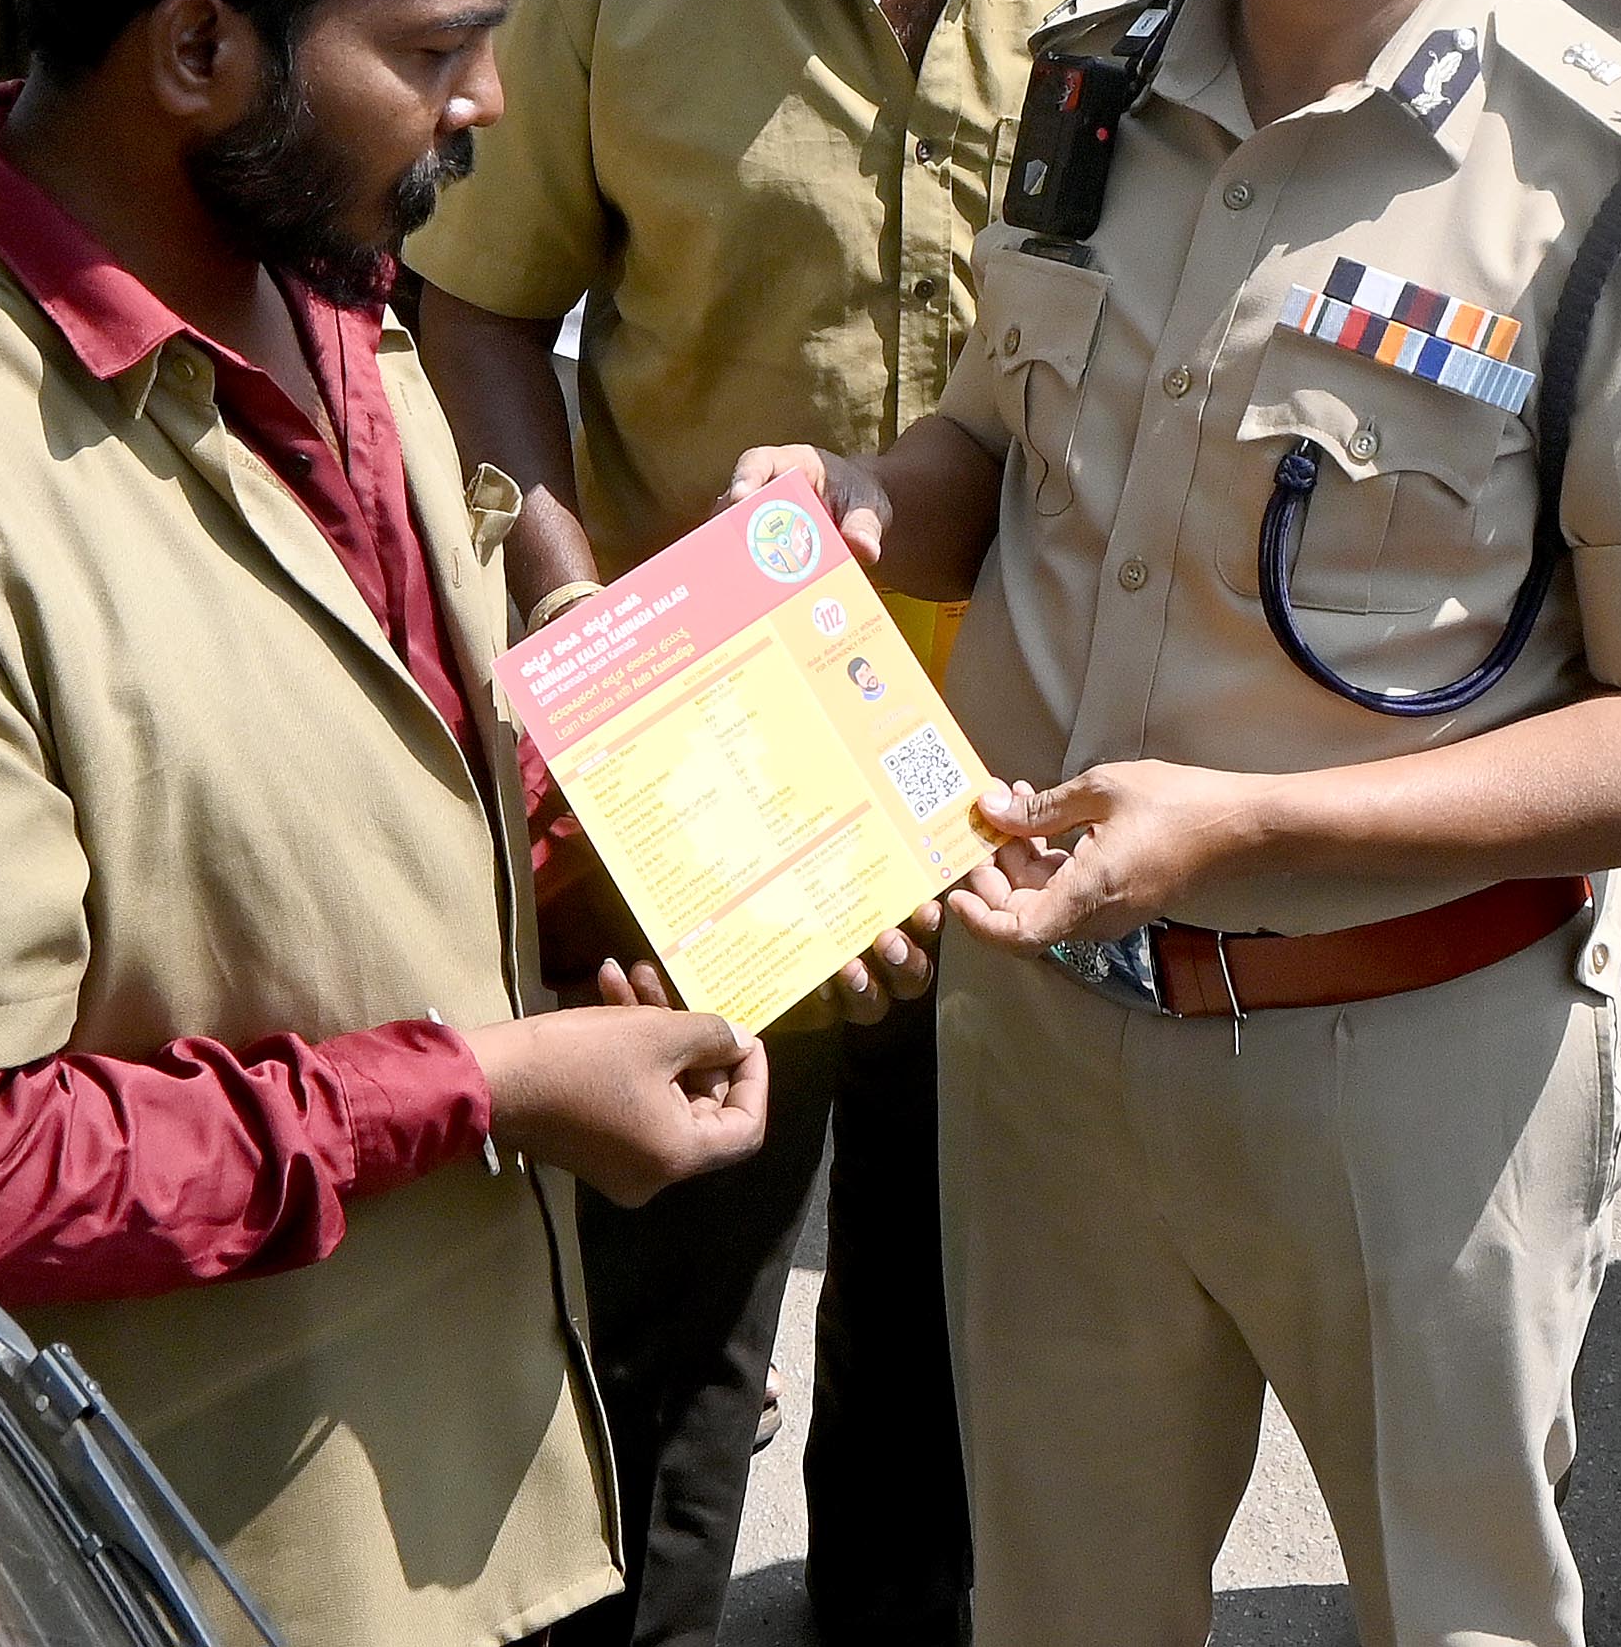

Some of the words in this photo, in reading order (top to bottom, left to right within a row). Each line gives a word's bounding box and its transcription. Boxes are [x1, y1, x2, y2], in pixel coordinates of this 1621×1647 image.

[520, 651, 552, 678] ಕನ್ನಡ
[582, 611, 613, 638] ಕನ್ನಡ
[529, 659, 578, 695] KANNADA
[576, 638, 609, 665] KALISI
[608, 608, 655, 644] KANNADA
[653, 586, 689, 615] BALASI
[818, 605, 845, 632] 112
[538, 690, 558, 706] Learn
[558, 671, 587, 693] Kannada
[588, 658, 608, 674] Speak
[608, 638, 637, 660] Kannada
[555, 720, 580, 740] Learn
[579, 696, 615, 724] Kannada
[615, 684, 632, 700] with
[631, 671, 652, 689] Auto
[652, 643, 695, 676] Kannadiga
